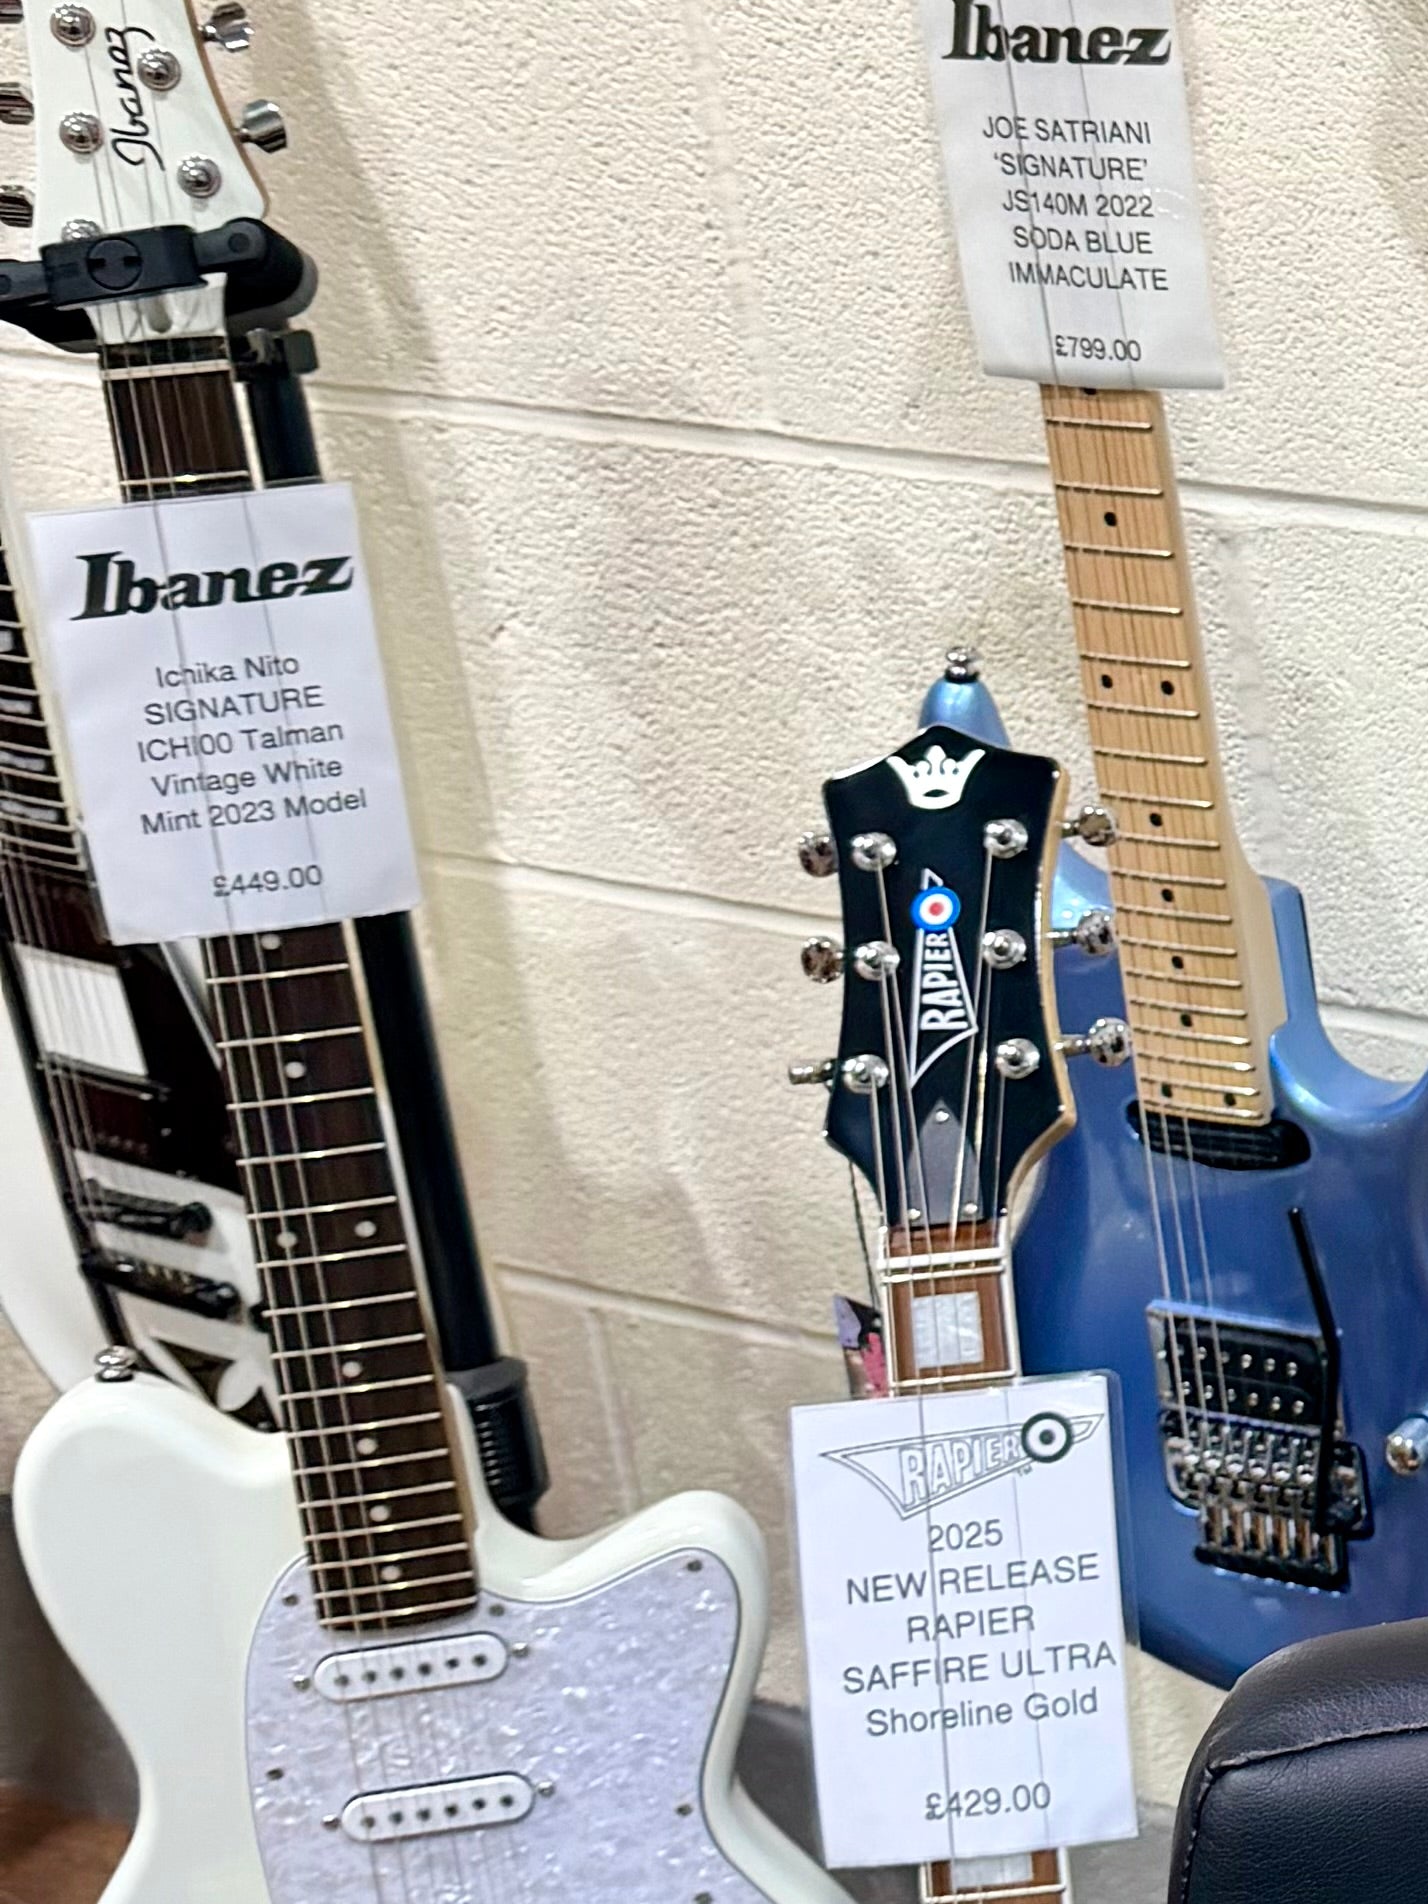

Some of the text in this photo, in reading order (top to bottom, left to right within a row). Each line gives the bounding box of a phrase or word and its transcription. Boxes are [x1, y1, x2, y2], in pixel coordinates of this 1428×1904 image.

[105, 27, 165, 171] Ibanez
[983, 116, 1151, 145] JOE SATRIANI
[1003, 189, 1153, 218] JS140M 2022
[1014, 226, 1152, 254] SODA BLUE
[1009, 261, 1169, 291] IMMACULATE
[1056, 334, 1142, 362] £799.00
[70, 551, 355, 621] Ibanez
[155, 654, 299, 689] Ichika Nito
[144, 685, 325, 725] SIGNATURE
[240, 722, 343, 751] Talman
[151, 757, 343, 797] Vintage White
[141, 788, 368, 836] Mint 2023 Model
[213, 864, 323, 897] £449.00
[920, 932, 969, 1031] RAPIER
[899, 1431, 1023, 1508] RAPIER
[928, 1519, 1003, 1552] 2025
[847, 1553, 1100, 1604] NEW RELEASE
[907, 1605, 1035, 1643] RAPIER
[843, 1641, 1117, 1695] SAFFIRE ULTRA
[866, 1687, 1098, 1738] Shoreline Gold
[925, 1781, 1051, 1821] £429.00
